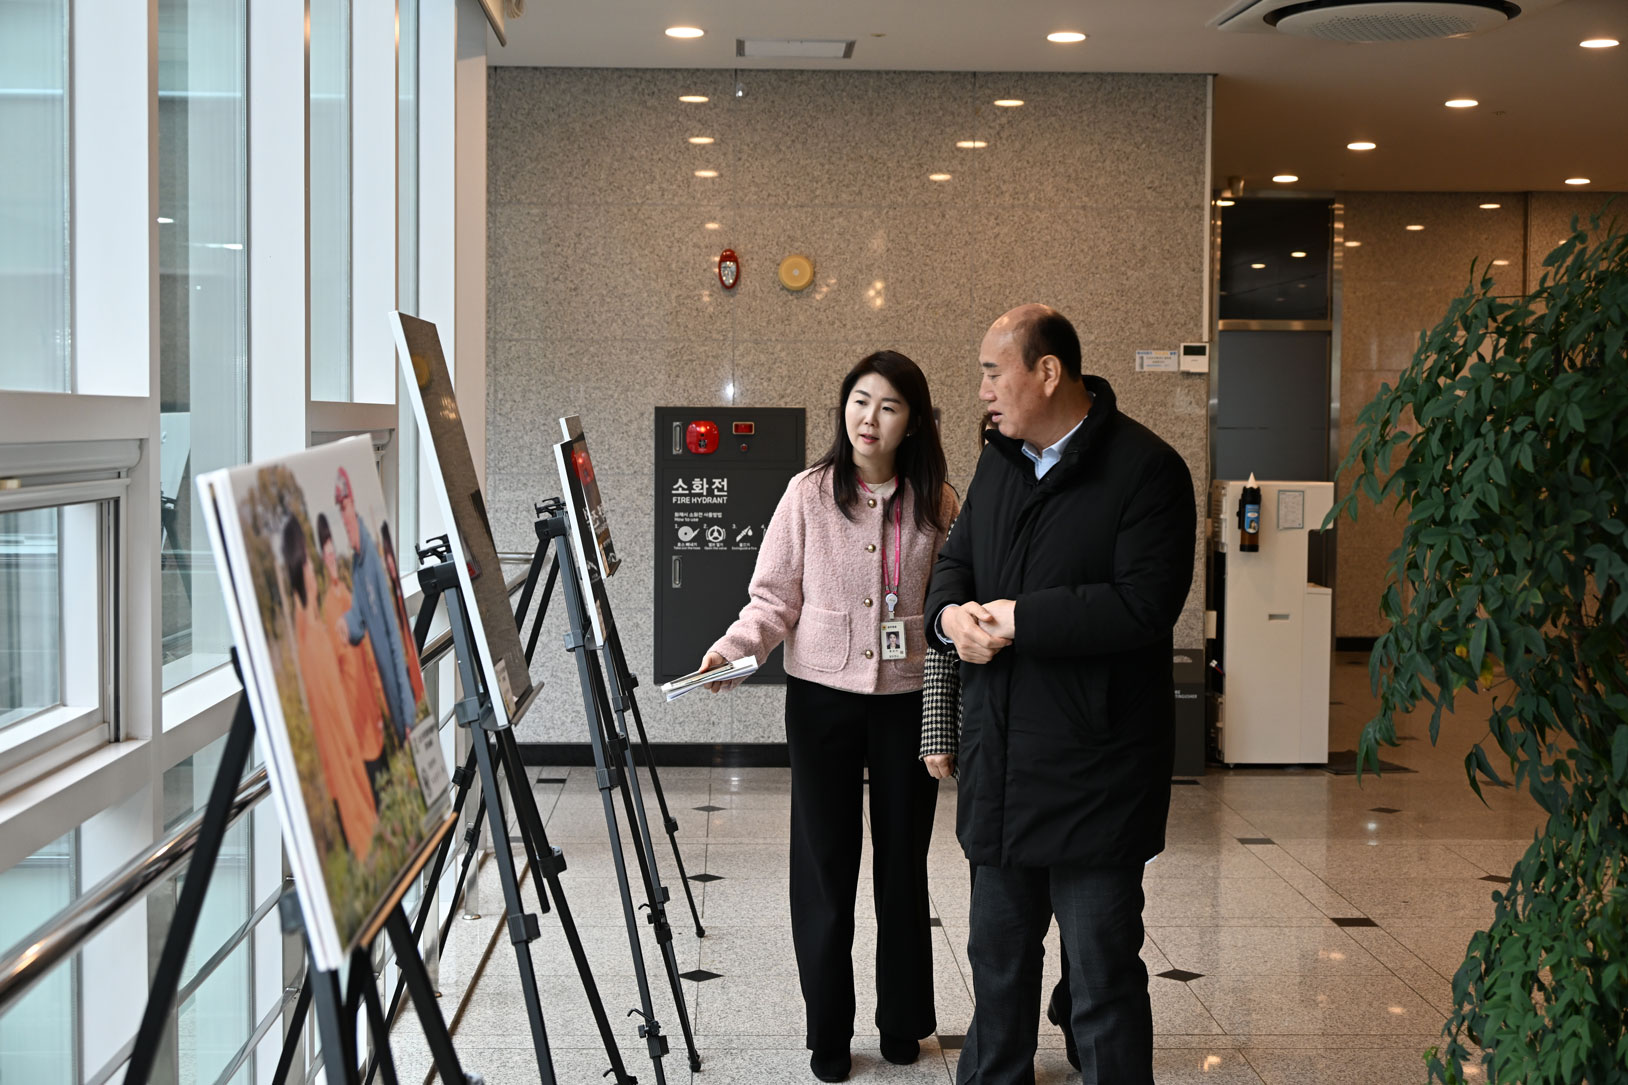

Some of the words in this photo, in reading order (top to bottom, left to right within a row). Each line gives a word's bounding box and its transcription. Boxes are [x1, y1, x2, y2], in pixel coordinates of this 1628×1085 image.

[671, 478, 728, 496] 소화전
[672, 496, 690, 504] FIRE
[691, 496, 728, 504] HYDRANT
